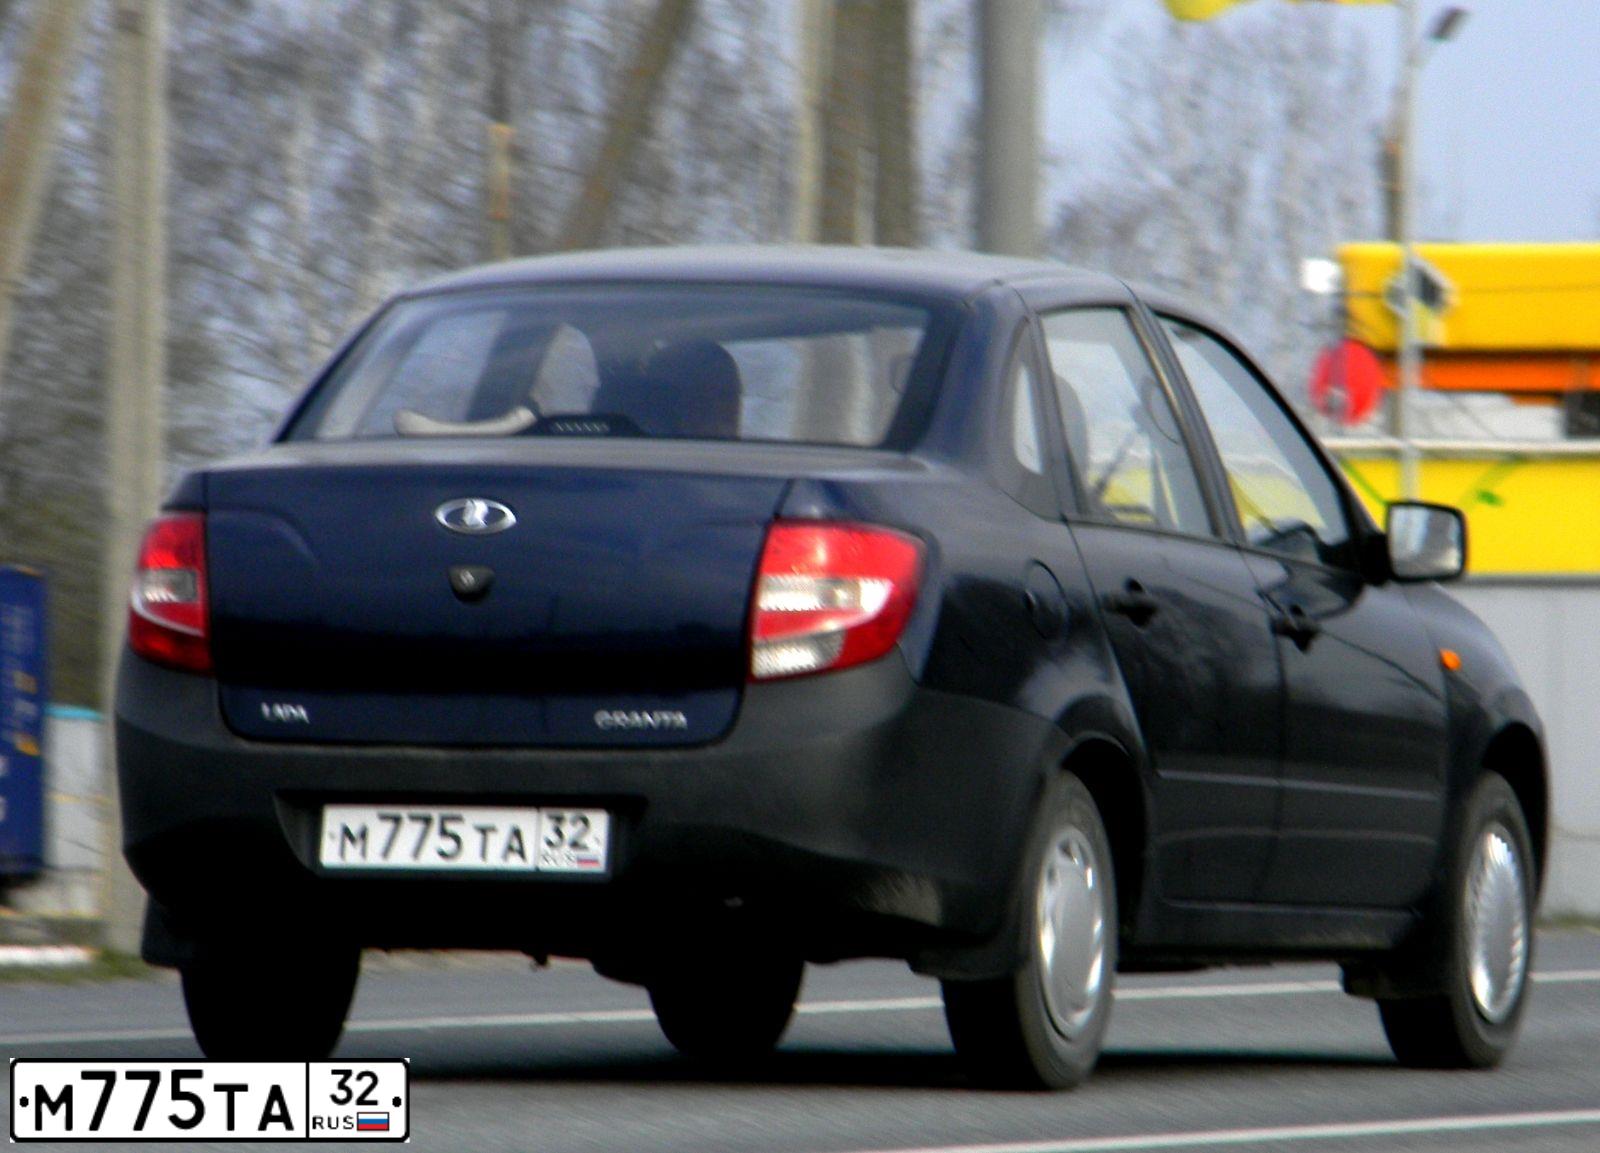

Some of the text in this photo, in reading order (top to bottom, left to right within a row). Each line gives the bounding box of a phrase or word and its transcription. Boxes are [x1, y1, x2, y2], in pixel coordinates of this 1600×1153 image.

[594, 710, 688, 730] GRANTA
[339, 810, 590, 864] М775ТА 32
